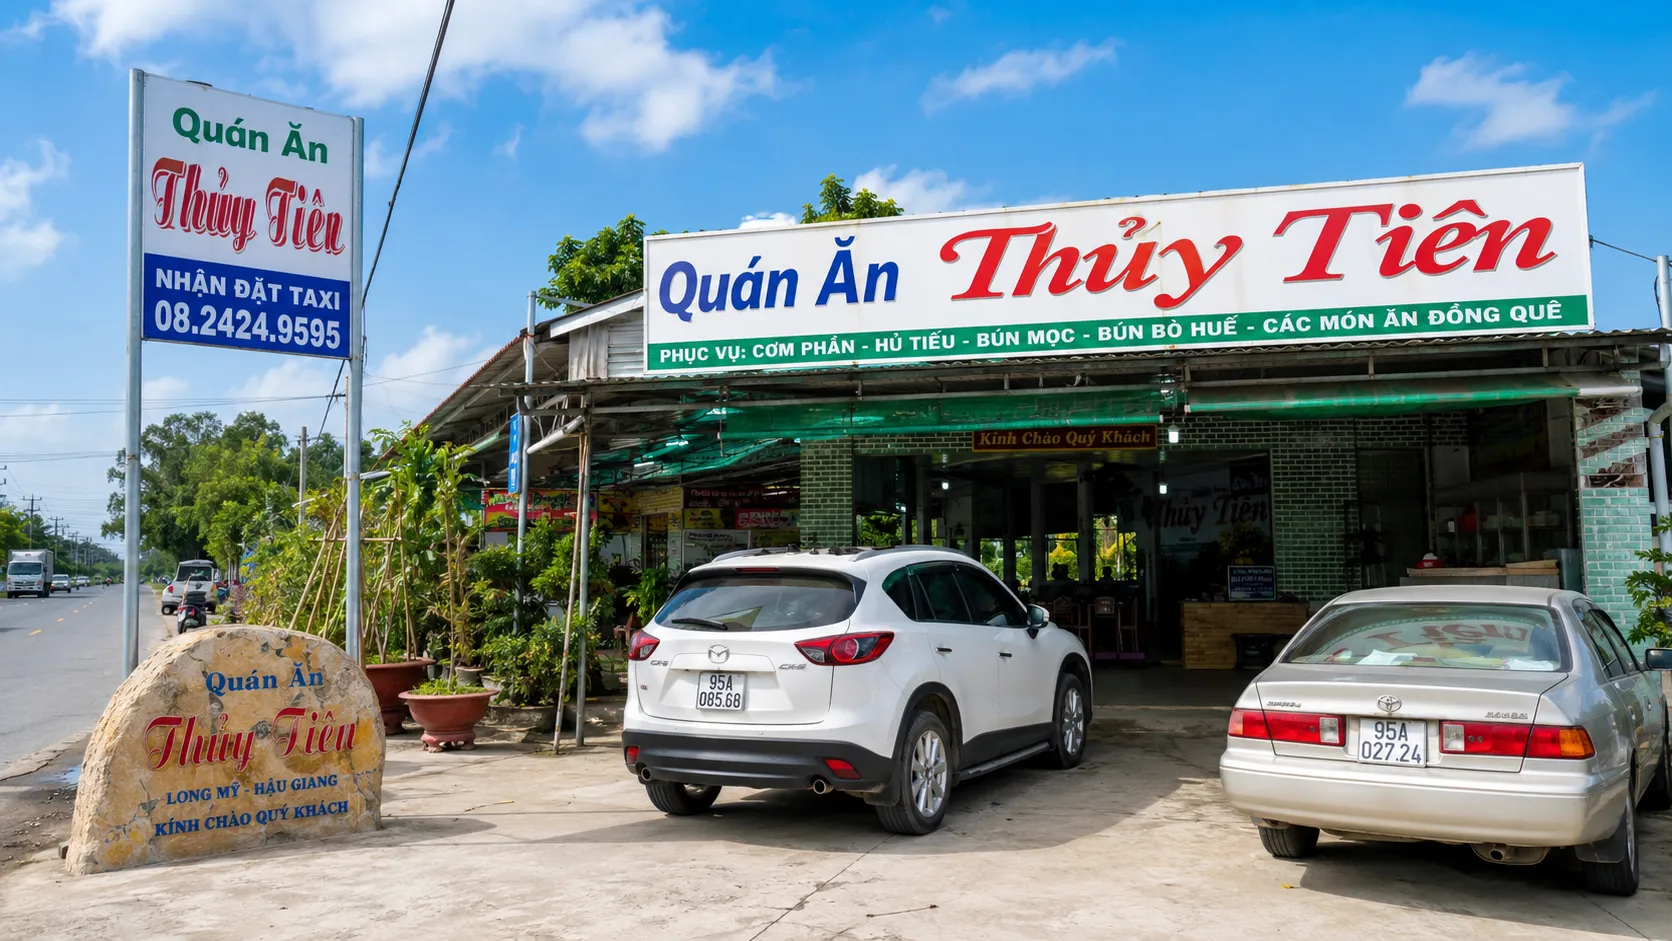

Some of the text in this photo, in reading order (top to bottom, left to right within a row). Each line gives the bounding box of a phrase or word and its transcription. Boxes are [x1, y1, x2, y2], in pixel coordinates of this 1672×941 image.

[173, 107, 328, 164] Quán Ăn
[151, 157, 345, 255] Thủy Tiên
[659, 199, 1557, 322] Quán Ăn Thủy Tiên
[156, 268, 340, 310] NHẬN ĐẶT TAXI
[155, 300, 340, 349] 08.2424.9595
[660, 346, 709, 365] PHỤC
[715, 344, 746, 361] VỤ:
[752, 342, 794, 358] CƠM
[801, 336, 855, 356] PHẦN
[875, 332, 903, 352] HỦ
[910, 330, 955, 351] TIẾU
[977, 328, 1021, 348] BÚN
[1026, 328, 1075, 348] MỌC
[1099, 320, 1144, 341] BÚN
[1152, 317, 1183, 339] BÒ
[1190, 315, 1239, 336] HUẾ
[1263, 313, 1314, 333] CÁC
[1320, 311, 1375, 331] MÓN
[1384, 308, 1418, 328] ĂN
[1428, 303, 1500, 325] ĐỒNG
[1509, 300, 1562, 322] QUÊ
[1102, 430, 1150, 443] Khách
[205, 662, 323, 697] Quán Ăn
[709, 675, 732, 691] 95A
[699, 693, 741, 708] 085.68
[143, 707, 357, 772] Thủy Tiên
[1374, 721, 1408, 741] 95A
[1362, 741, 1421, 764] 027.24
[166, 788, 211, 805] LONG
[254, 777, 287, 797] HẬU
[291, 774, 338, 792] GIANG
[155, 801, 348, 836] KÍNH CHÀO QUÝ KHÁCH
